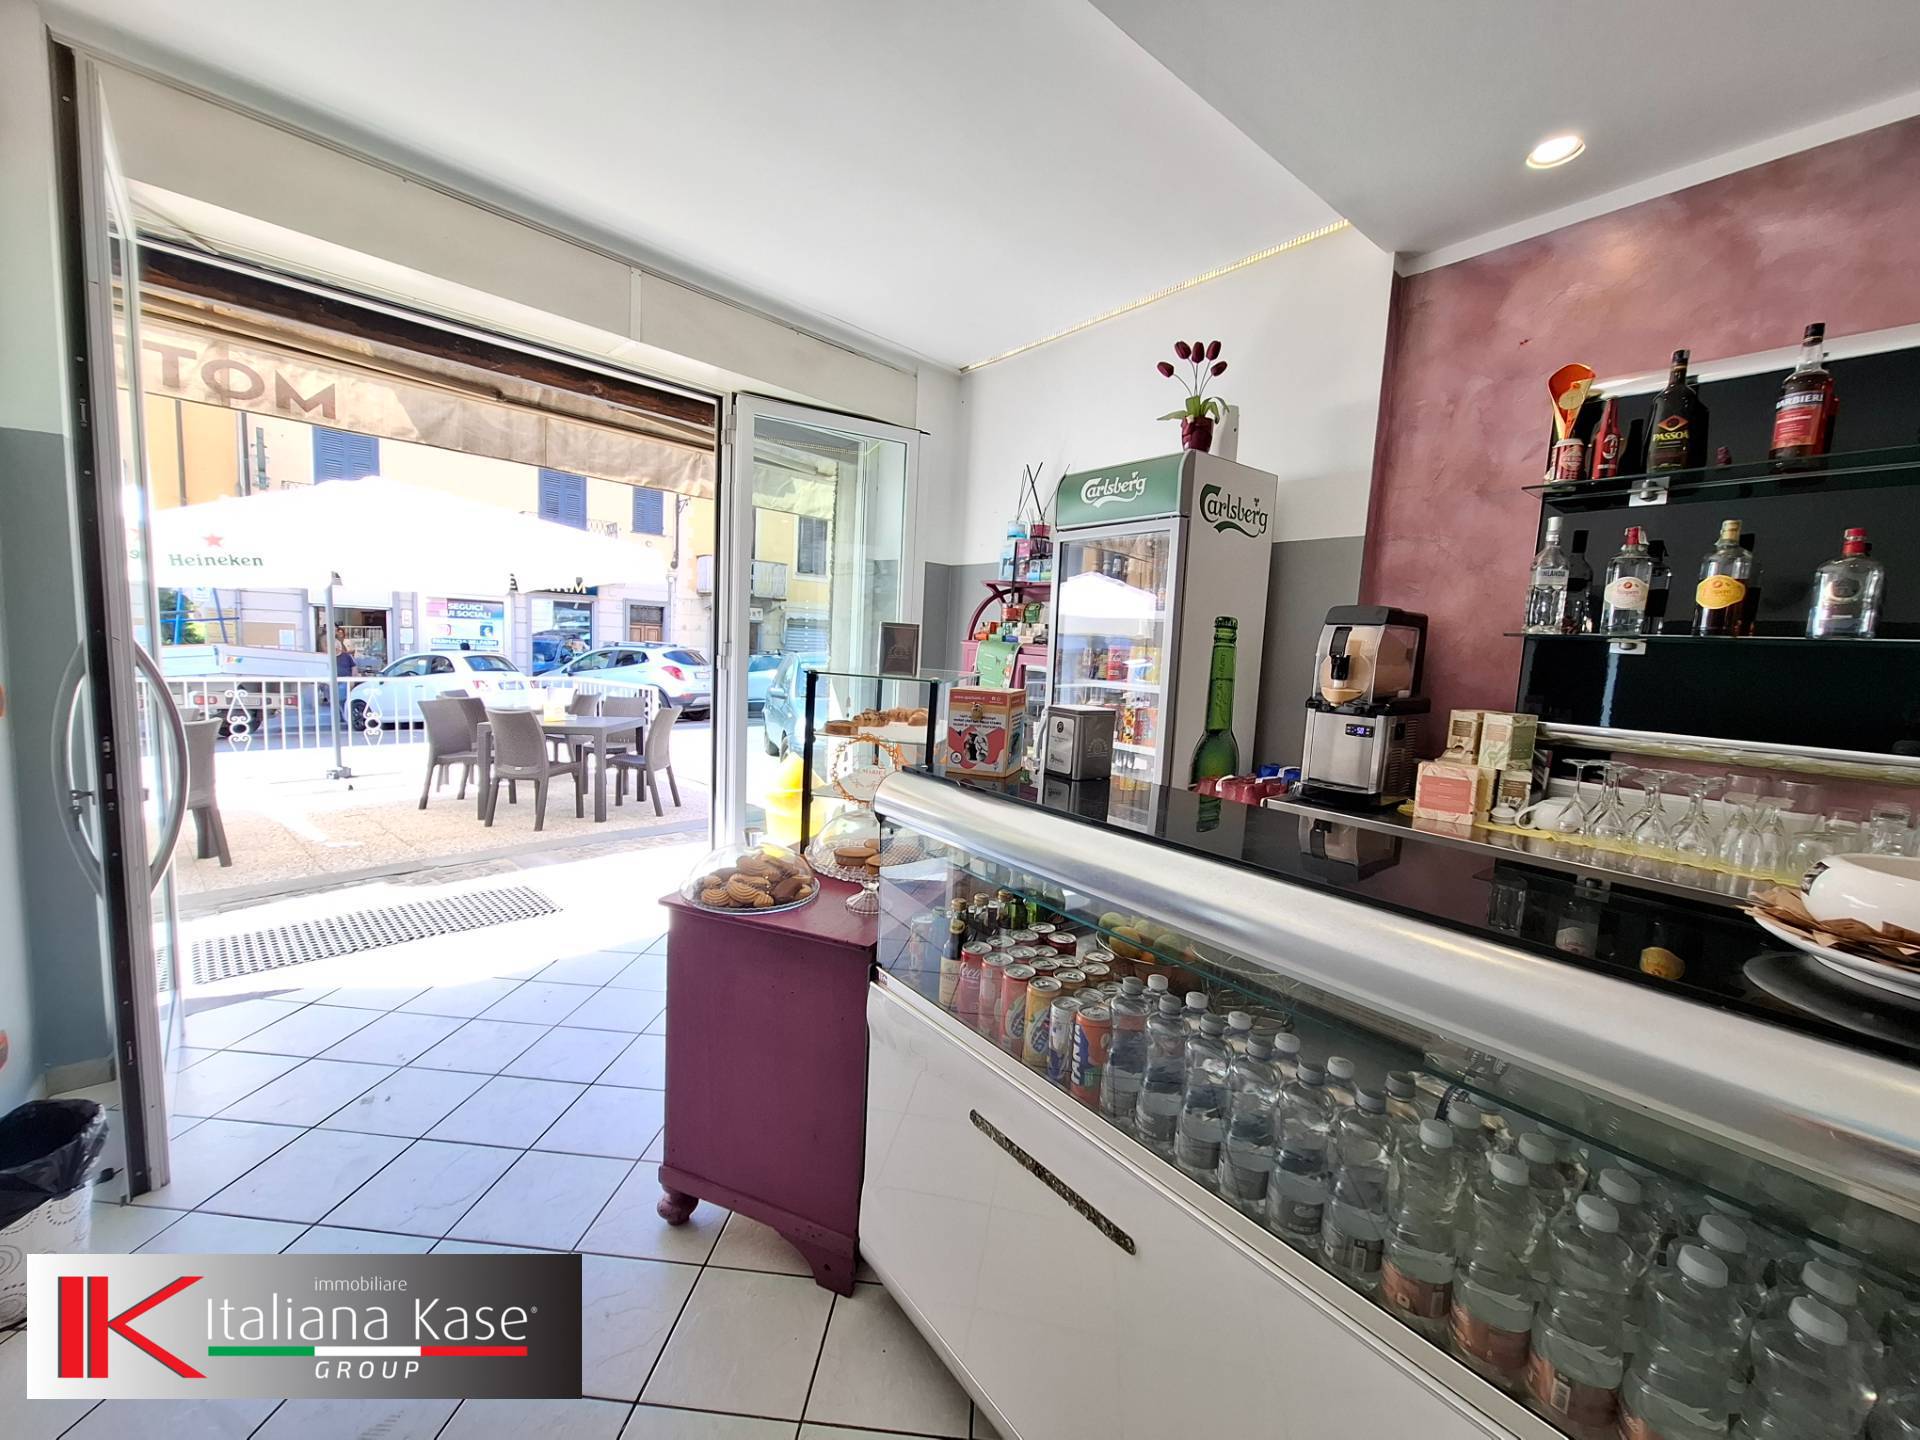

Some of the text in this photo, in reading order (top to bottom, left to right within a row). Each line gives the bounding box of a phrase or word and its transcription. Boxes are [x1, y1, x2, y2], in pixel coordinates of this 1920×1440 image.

[1081, 471, 1148, 508] Carlsberg
[1200, 483, 1269, 538] Carlsberg
[168, 553, 264, 567] Heineken
